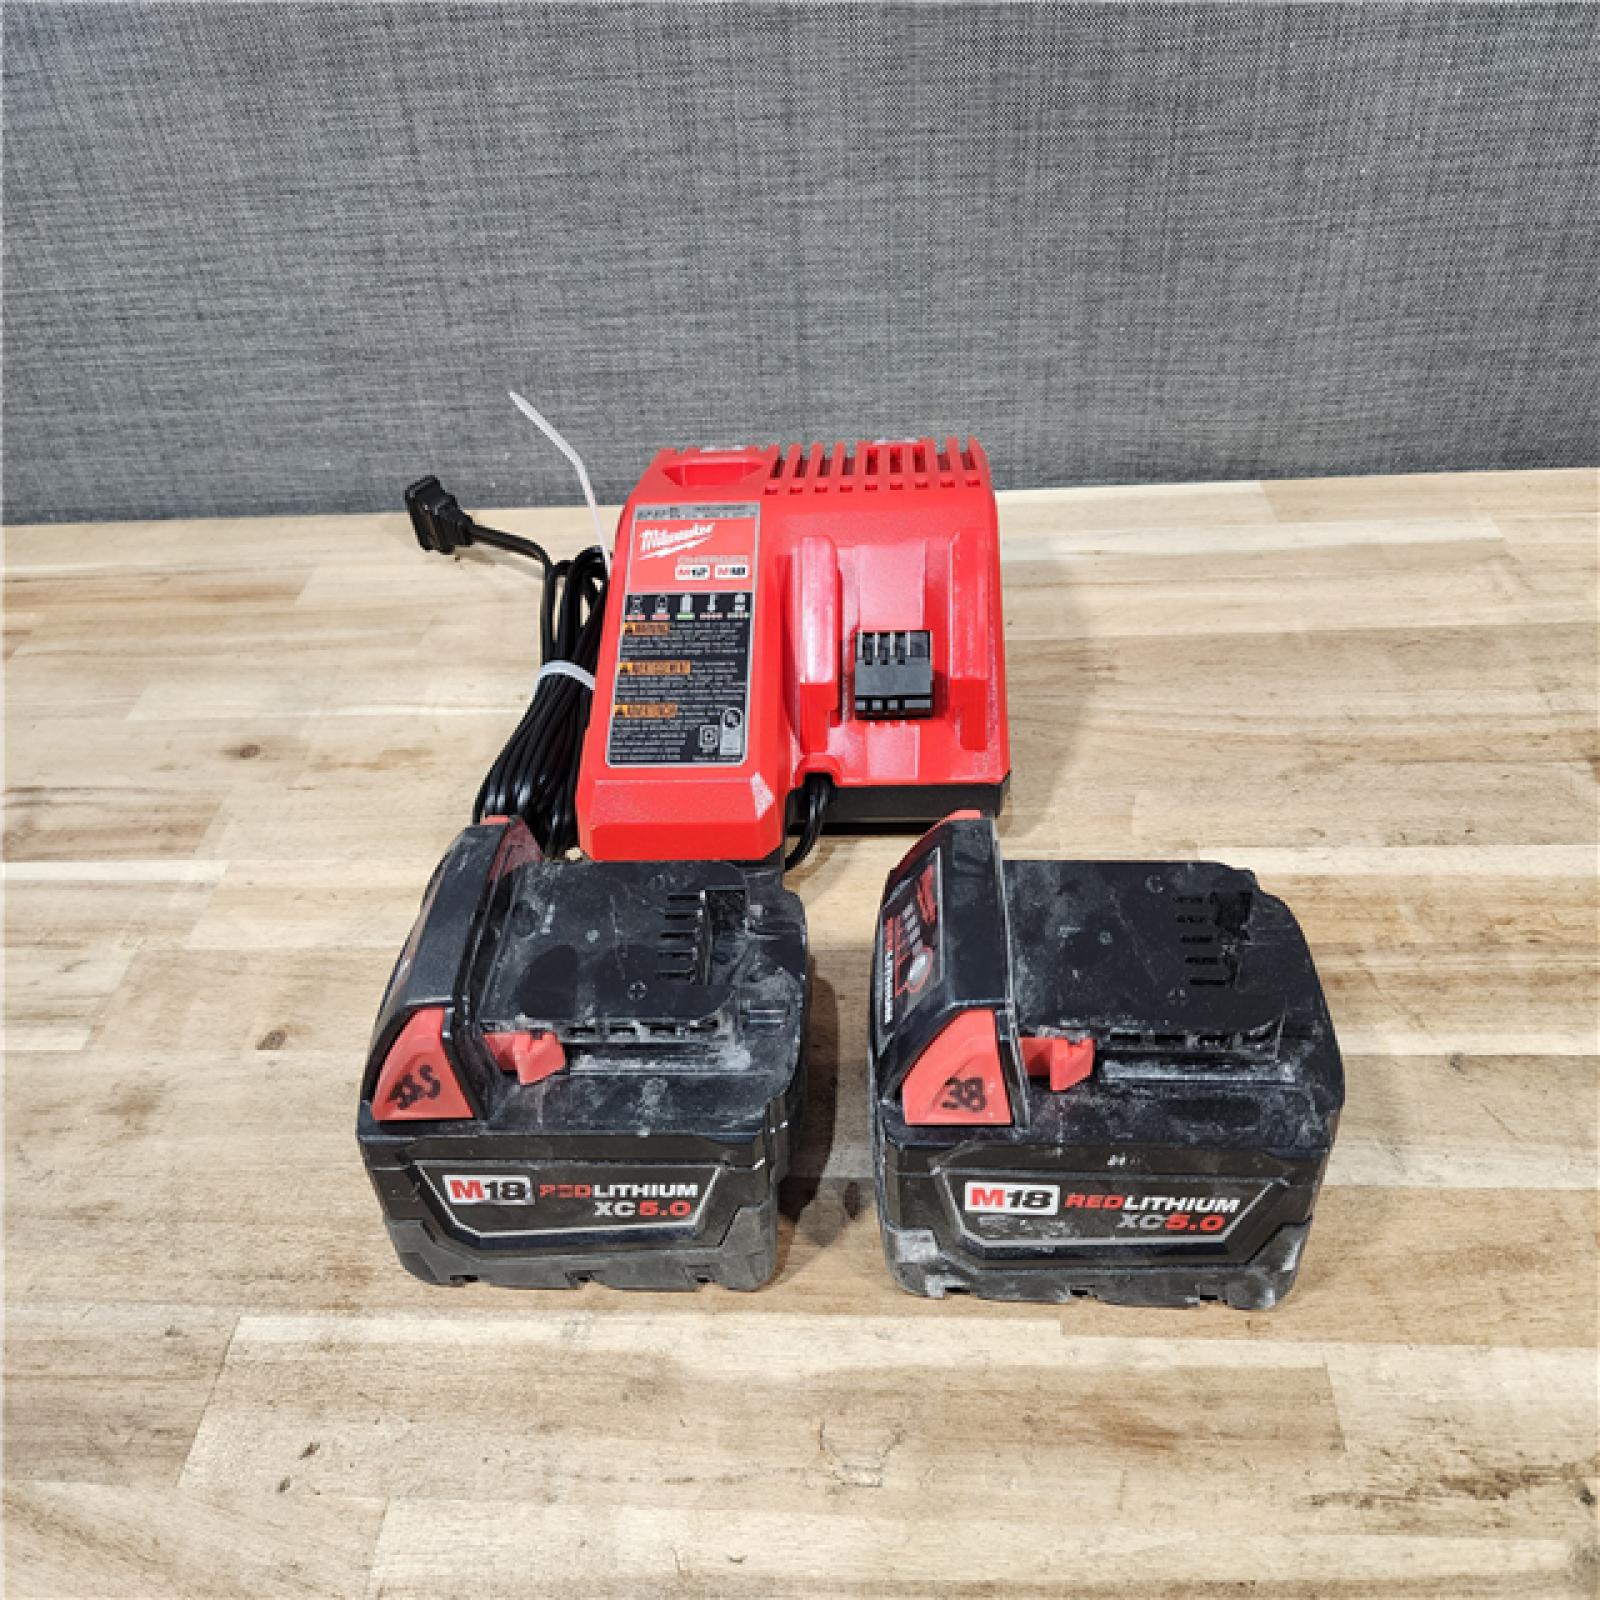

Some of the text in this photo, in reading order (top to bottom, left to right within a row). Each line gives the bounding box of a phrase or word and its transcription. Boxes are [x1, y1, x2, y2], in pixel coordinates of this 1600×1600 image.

[450, 1179, 527, 1200] M18
[971, 1188, 1240, 1213] M18 REDLITHIUM
[1116, 1214, 1226, 1231] XC5.0
